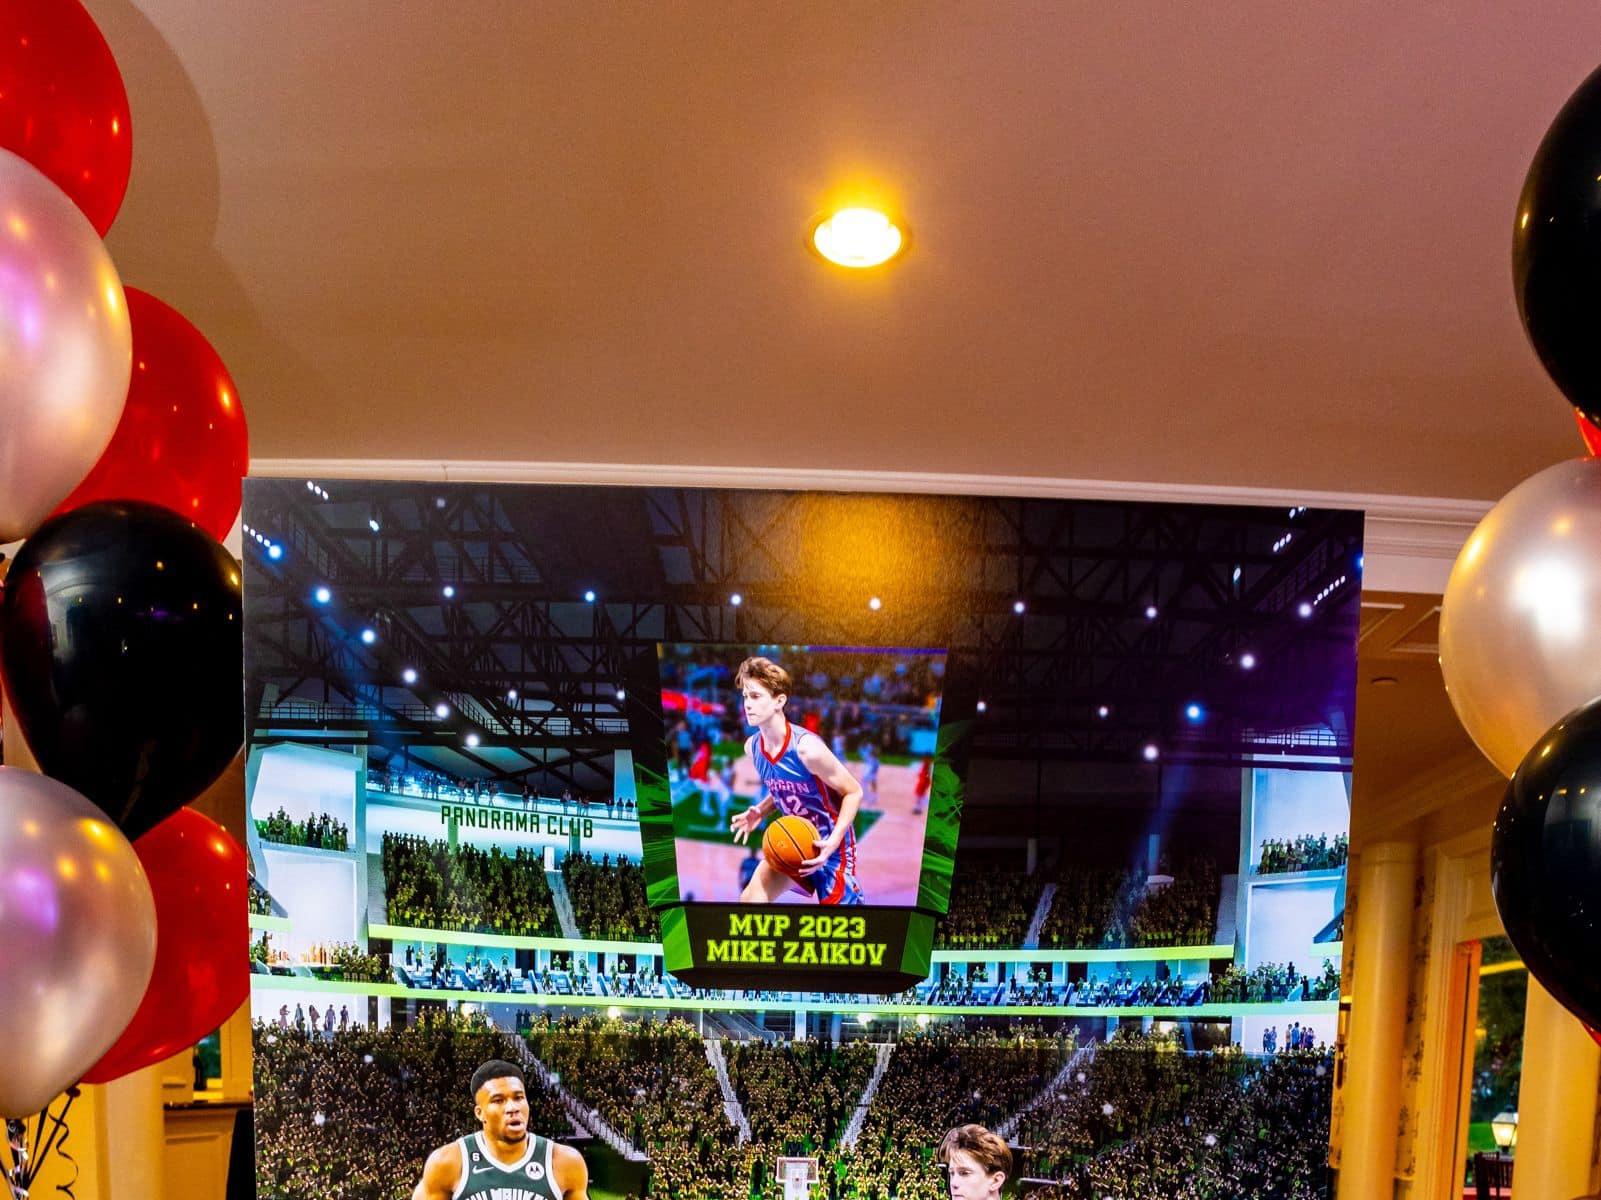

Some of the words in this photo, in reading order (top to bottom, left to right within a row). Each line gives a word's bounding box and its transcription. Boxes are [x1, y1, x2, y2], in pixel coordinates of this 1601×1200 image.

[441, 806, 539, 833] PANORAMA
[547, 816, 593, 838] CLUB
[729, 913, 790, 936] MVP
[799, 915, 865, 938] 2023
[707, 940, 776, 962] MIKE
[783, 941, 886, 966] ZAIKOV
[473, 1153, 479, 1161] 6
